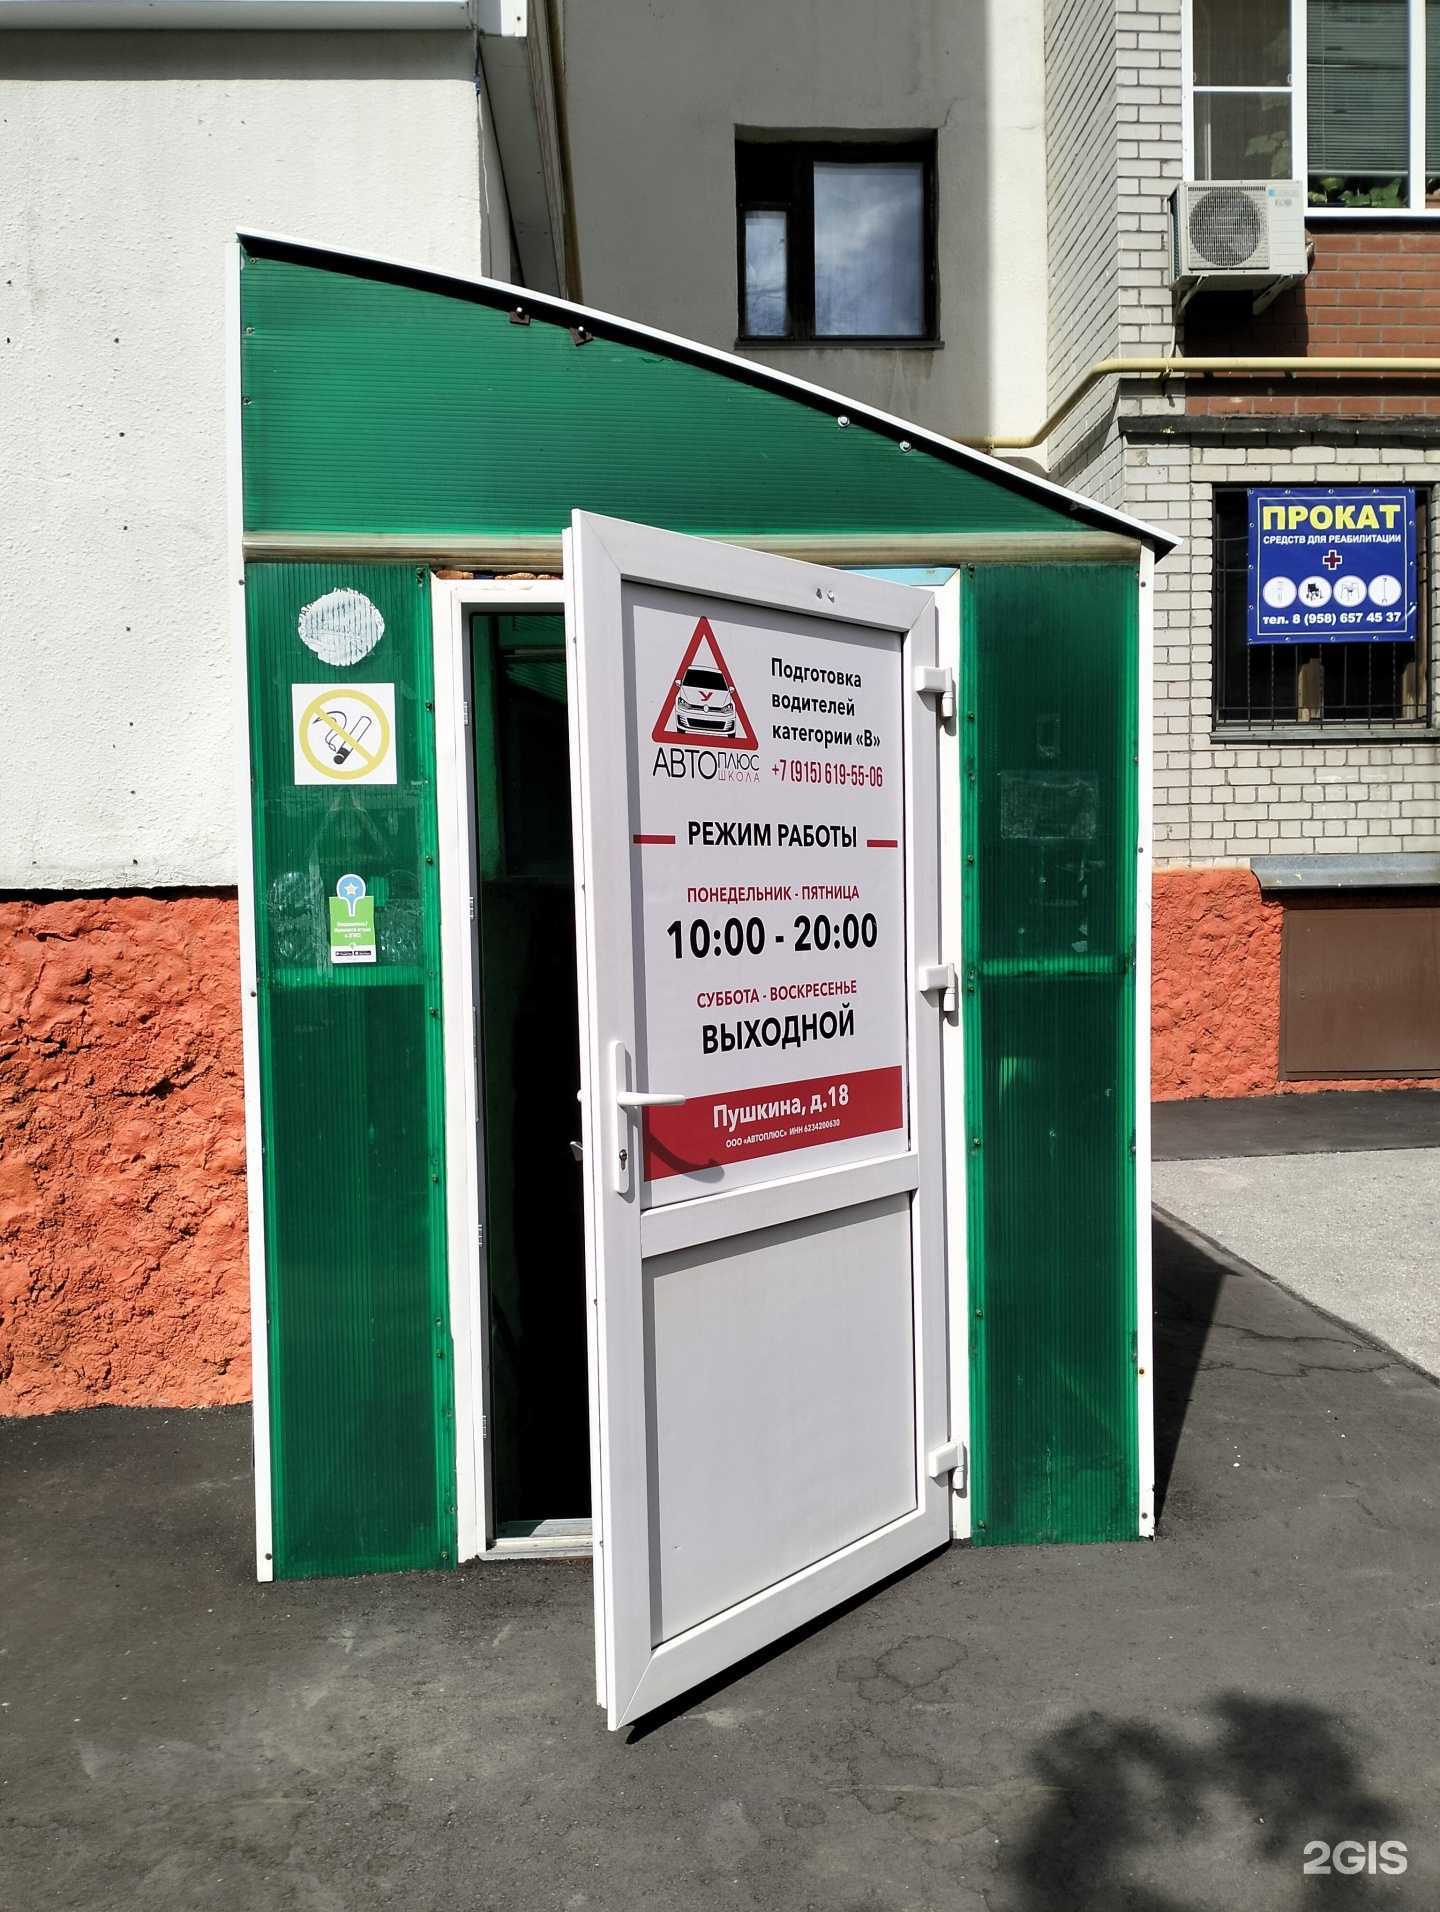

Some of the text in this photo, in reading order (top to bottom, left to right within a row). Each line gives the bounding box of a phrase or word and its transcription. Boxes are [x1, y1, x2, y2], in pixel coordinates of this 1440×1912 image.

[1262, 504, 1401, 530] ПРОКАТ
[1263, 534, 1402, 545] СРЕДСТВ ДЛЯ РЕАБИЛИТАЦИИ
[1263, 611, 1402, 626] тел. 8 (958) 657 45 37
[771, 657, 862, 689] Подготовка
[772, 693, 855, 717] водителей
[772, 723, 853, 748] категории
[718, 770, 761, 783] ШКОЛА
[771, 759, 883, 787] +7 (915) 619-55-06
[687, 821, 858, 848] РЕЖИМ РАБОТЫ
[687, 886, 792, 904] ПОНЕДЕЛЬНИК
[801, 884, 860, 901] ПЯТНИЦА
[666, 916, 765, 960] 10:00
[793, 912, 878, 952] 20:00
[696, 988, 760, 1009] СУББОТА
[769, 980, 857, 1002] ВОСКРЕСЕНЬЕ
[702, 1002, 855, 1055] ВЫХОДНОЙ
[713, 1084, 849, 1132] Пушкина, д.18
[726, 1137, 743, 1148] ООО
[743, 1129, 788, 1145] «АВТОПЛЮС»
[789, 1124, 803, 1136] ИНН
